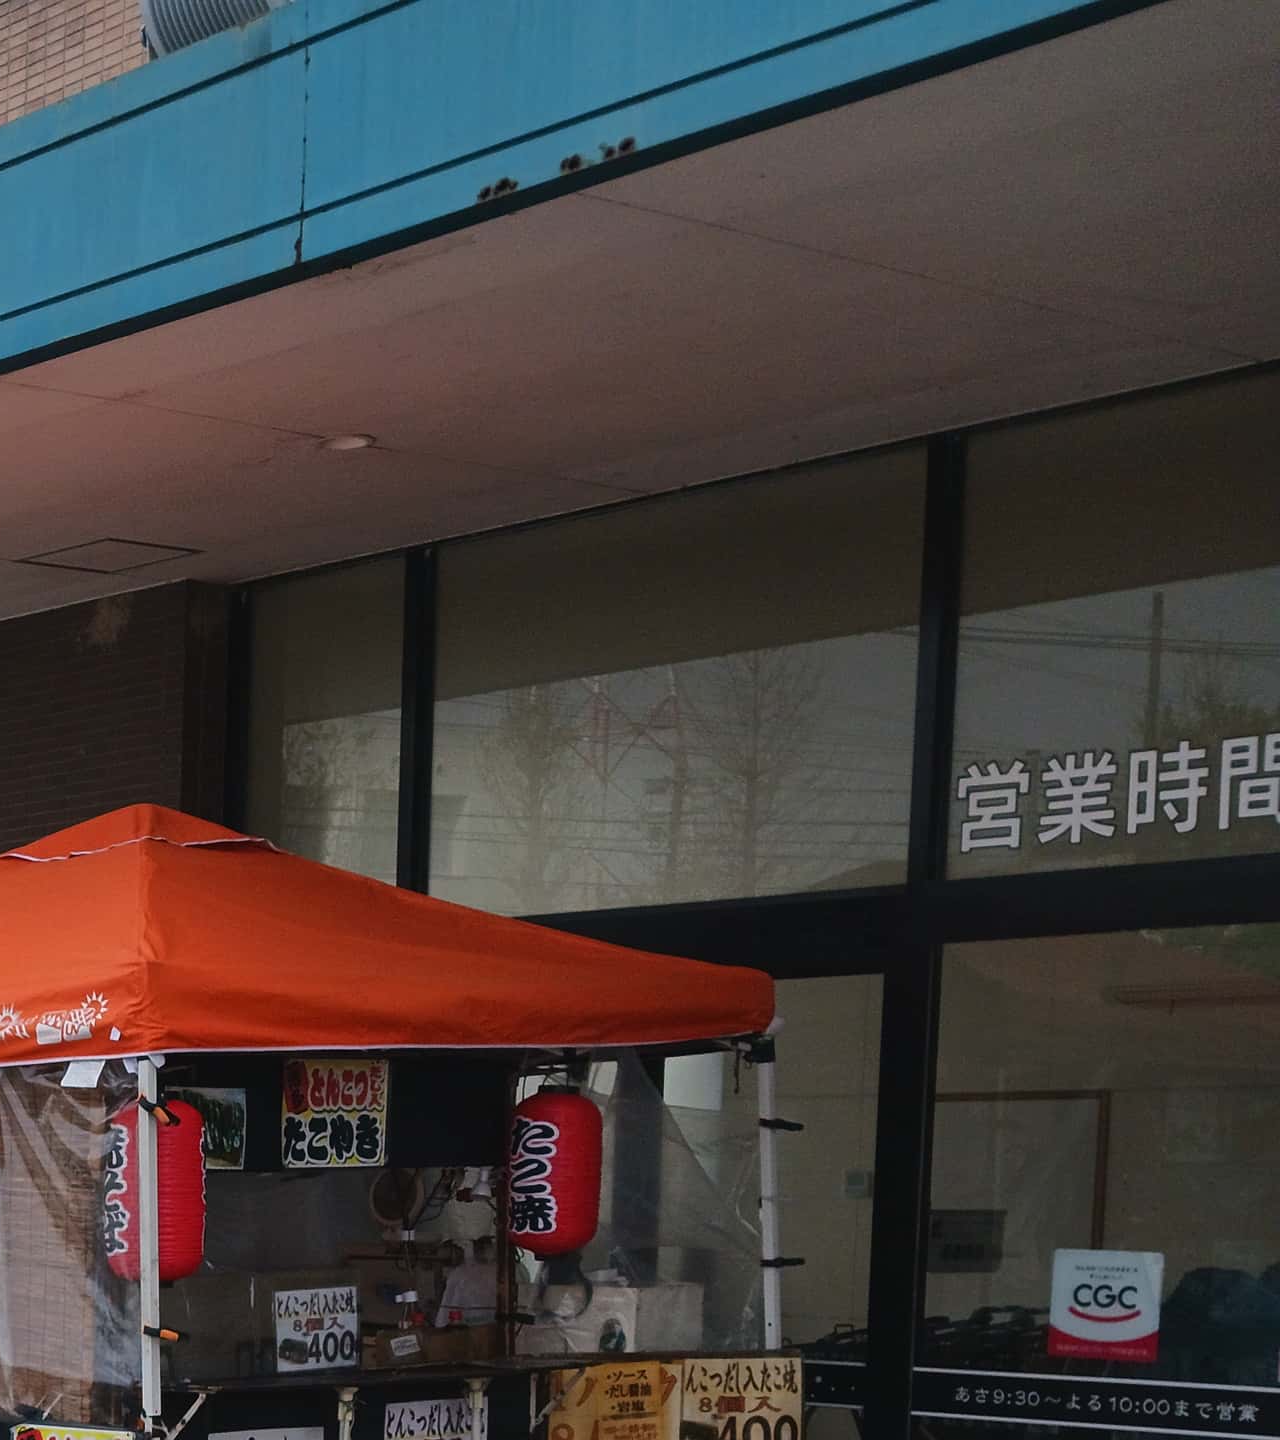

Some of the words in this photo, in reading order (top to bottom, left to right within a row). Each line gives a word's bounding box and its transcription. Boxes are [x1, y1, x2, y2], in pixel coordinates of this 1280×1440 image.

[957, 732, 1280, 853] 営業時間
[310, 1067, 369, 1108] とんこつ
[284, 1114, 380, 1162] たこやき
[510, 1117, 557, 1233] たこ焼
[1073, 1283, 1138, 1310] CGC
[306, 1329, 355, 1364] 400
[386, 1402, 485, 1439] とんこつだし入たこ
